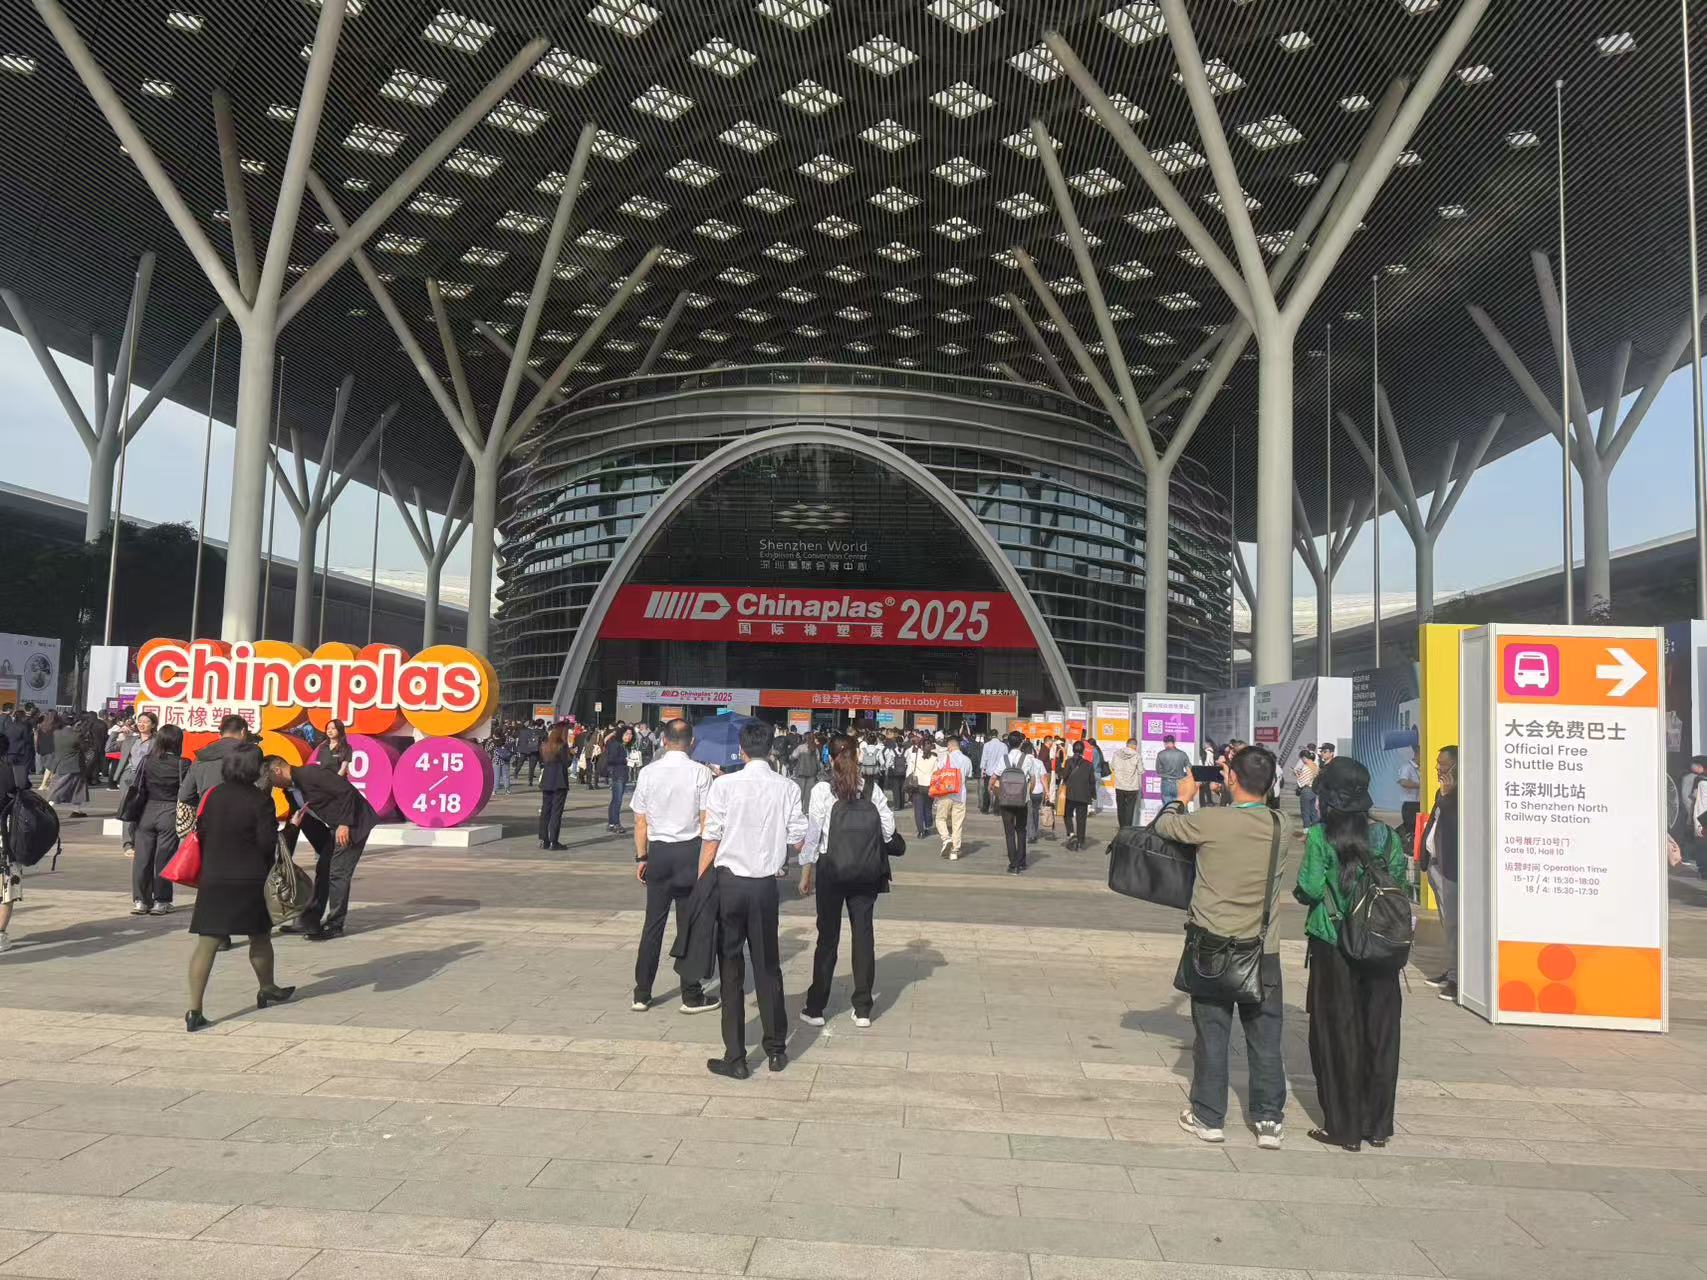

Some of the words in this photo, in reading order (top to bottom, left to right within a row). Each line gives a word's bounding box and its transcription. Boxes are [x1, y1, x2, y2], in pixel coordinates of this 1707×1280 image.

[760, 540, 823, 551] Shenzhen
[827, 541, 868, 552] World
[897, 599, 991, 641] 2025
[738, 622, 884, 638] 国际橡塑展
[143, 643, 480, 723] Chinaplas
[713, 692, 733, 702] 2025
[811, 694, 882, 705] 南登录大厅东侧
[884, 696, 911, 705] South
[913, 698, 941, 708] Lobby
[943, 699, 963, 708] East
[142, 705, 257, 730] 国际橡塑展
[1505, 719, 1627, 741] 大会免费巴士
[1504, 743, 1554, 756] Official
[1558, 745, 1588, 757] Free
[1504, 758, 1554, 770] Shuttle
[1558, 760, 1584, 772] Bus
[1505, 781, 1587, 799] 往深圳北站
[1504, 800, 1517, 809] To
[1520, 801, 1575, 812] Shenzhen
[1577, 803, 1608, 813] North
[1504, 812, 1548, 824] Railway
[1550, 813, 1591, 824] Station
[1526, 847, 1536, 855] 10,
[1556, 848, 1565, 856] 10
[1504, 862, 1541, 872] 运营时间
[1543, 863, 1585, 873] Operation
[1587, 864, 1608, 873] Time
[1513, 874, 1535, 882] 15-17
[1542, 876, 1550, 884] 4:
[1553, 876, 1600, 885] 15:30-18:00
[1526, 885, 1534, 893] 18
[1542, 886, 1550, 894] 4:
[1553, 886, 1599, 896] 15:30-17:30
